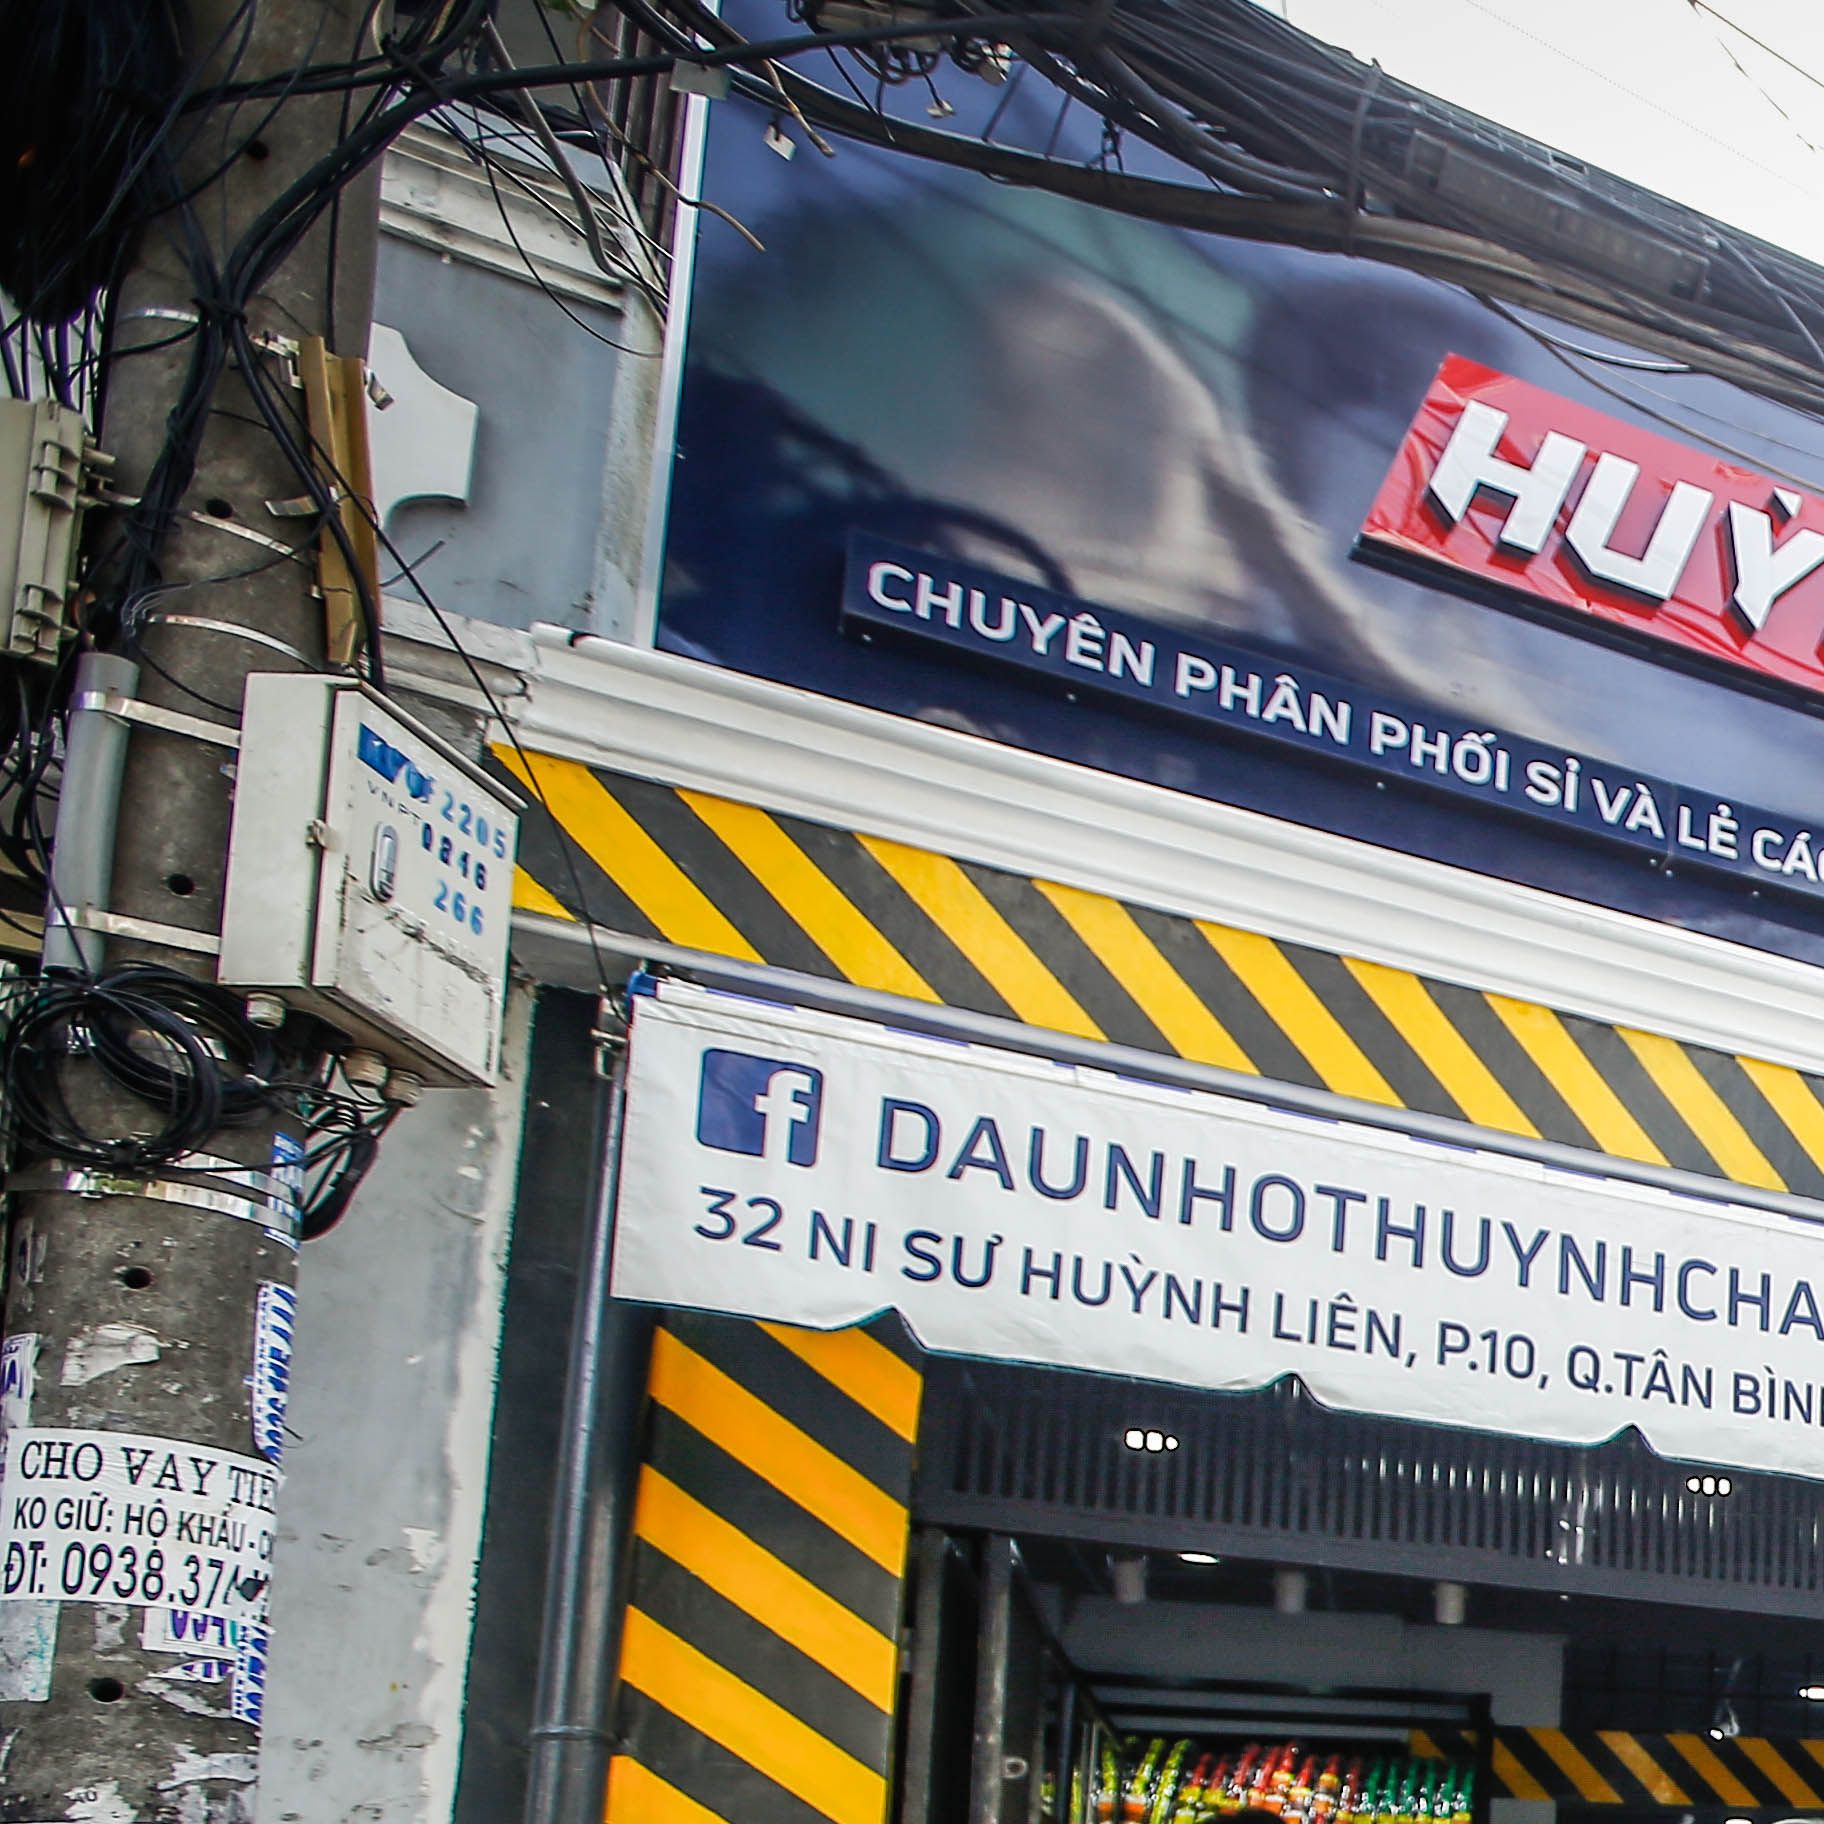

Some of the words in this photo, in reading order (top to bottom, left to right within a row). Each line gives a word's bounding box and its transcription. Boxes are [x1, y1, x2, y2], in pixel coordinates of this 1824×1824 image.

[868, 560, 1156, 687] CHUYÊN
[1174, 652, 1351, 745] PHÂN
[1370, 711, 1510, 793] PHỐI
[1525, 755, 1580, 812] SỈ
[1592, 778, 1664, 840] VÀ
[1677, 803, 1739, 860] LẺ
[693, 1186, 783, 1251] 32
[809, 1209, 876, 1273] NI
[901, 1228, 1003, 1289] SƯ
[1020, 1247, 1250, 1334] HUỲNH
[1272, 1291, 1417, 1368] LIÊN,
[1436, 1321, 1549, 1390] P.10,
[1566, 1345, 1714, 1426] Q.TÂN
[21, 1440, 103, 1482] CHO
[14, 1497, 47, 1530] KO
[55, 1491, 114, 1533] GIỮ:
[124, 1498, 168, 1546] HỘ
[177, 1499, 247, 1552] KHẨU
[4, 1541, 48, 1594] ĐT:
